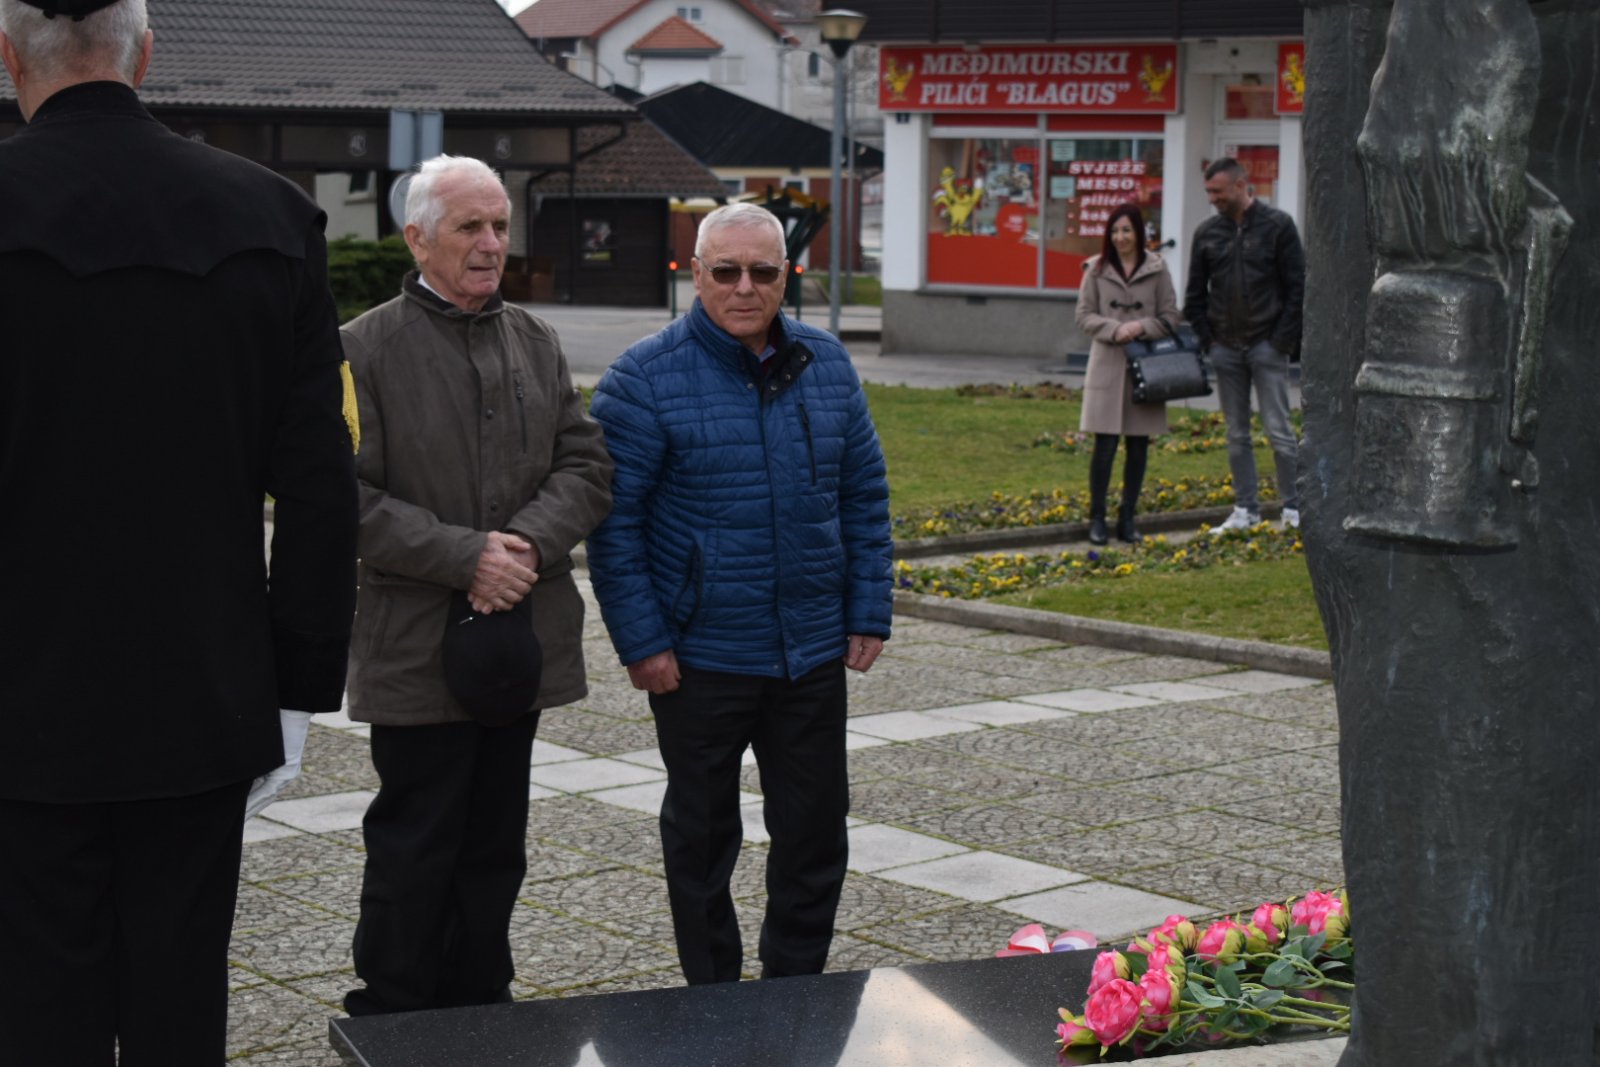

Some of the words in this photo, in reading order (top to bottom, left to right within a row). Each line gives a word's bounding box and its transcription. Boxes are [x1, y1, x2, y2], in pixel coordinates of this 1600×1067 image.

[921, 52, 1130, 75] MEĐIMURSKI
[920, 77, 989, 105] PILIĆI
[1069, 160, 1146, 174] SVJEŽE
